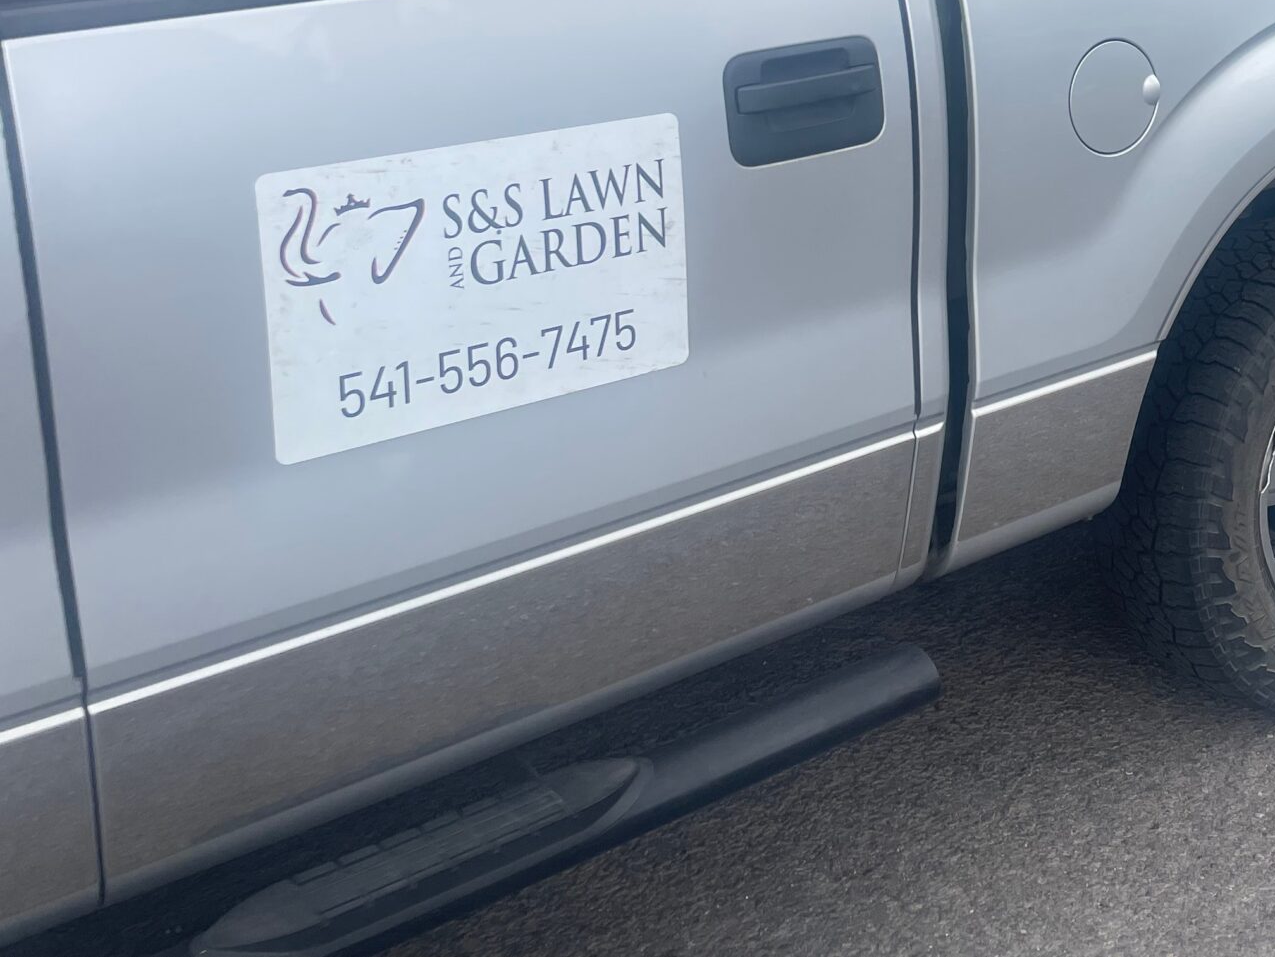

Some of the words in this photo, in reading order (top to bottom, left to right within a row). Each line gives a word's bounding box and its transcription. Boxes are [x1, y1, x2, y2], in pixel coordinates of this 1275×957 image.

[442, 182, 524, 239] S&S
[540, 158, 665, 221] LAWN
[448, 246, 466, 290] AND
[469, 207, 669, 286] GARDEN
[338, 308, 637, 419] 541-556-7475
